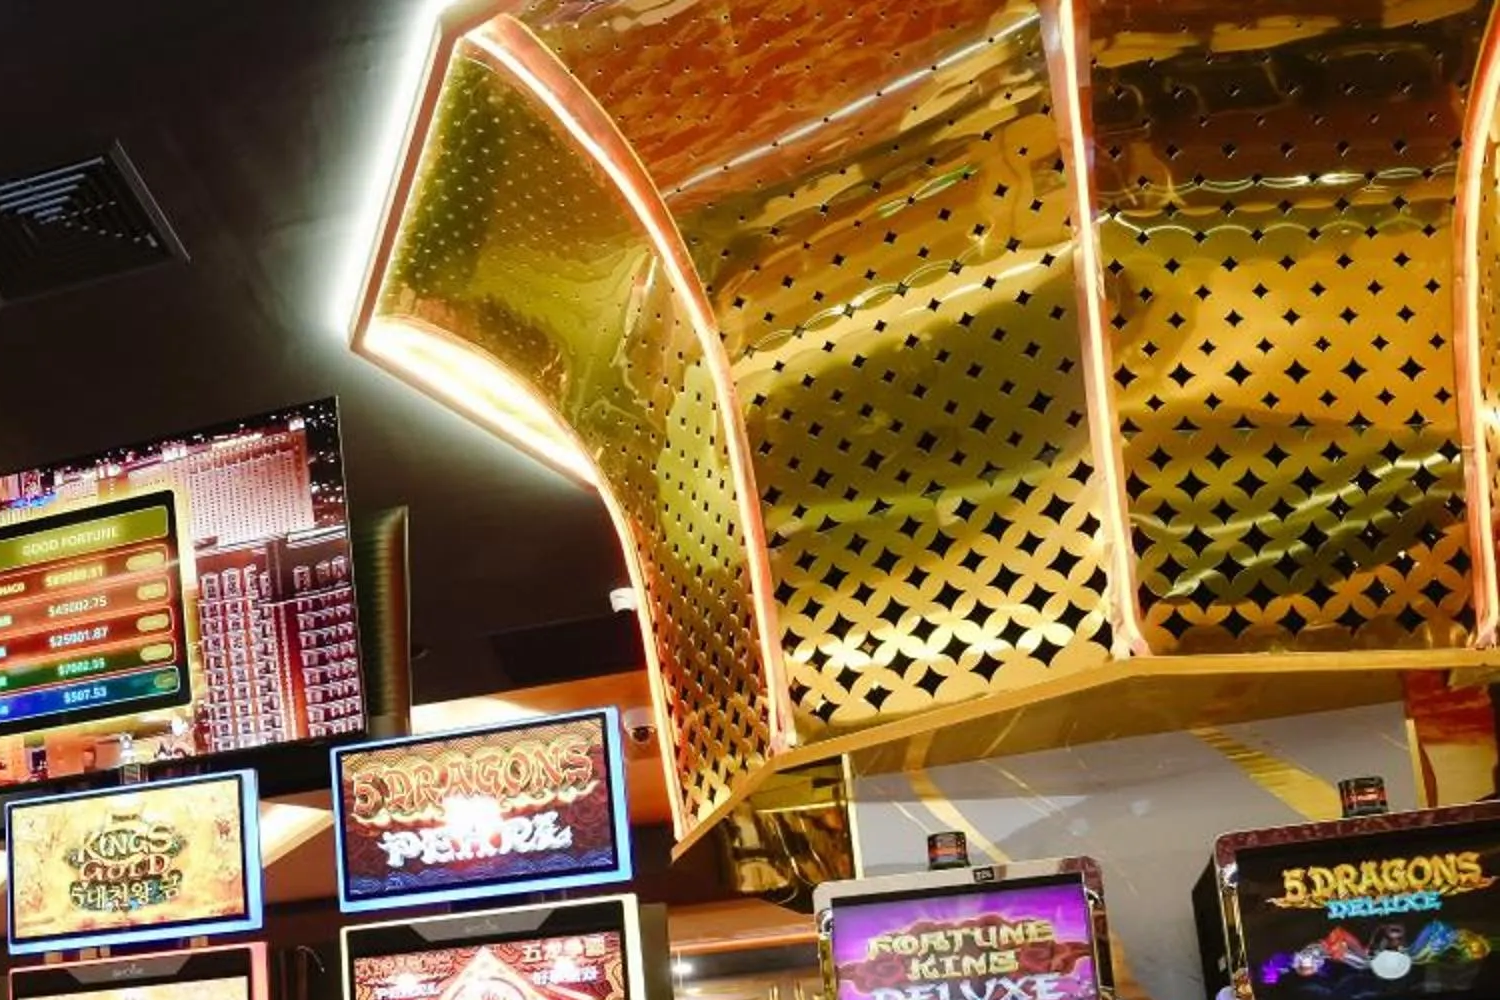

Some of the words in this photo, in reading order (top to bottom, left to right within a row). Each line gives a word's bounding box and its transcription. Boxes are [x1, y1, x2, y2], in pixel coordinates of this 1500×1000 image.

[22, 538, 59, 557] GOOD
[61, 526, 118, 547] FORTUNE
[353, 772, 383, 817] 5
[384, 740, 594, 812] DRAGONS
[378, 811, 573, 867] PEARL
[80, 853, 170, 881] GOLD
[1282, 868, 1307, 900] 5
[1307, 851, 1482, 899] DRAGONS
[1325, 890, 1442, 920] DELUXE
[868, 919, 1056, 962] FORTUNE
